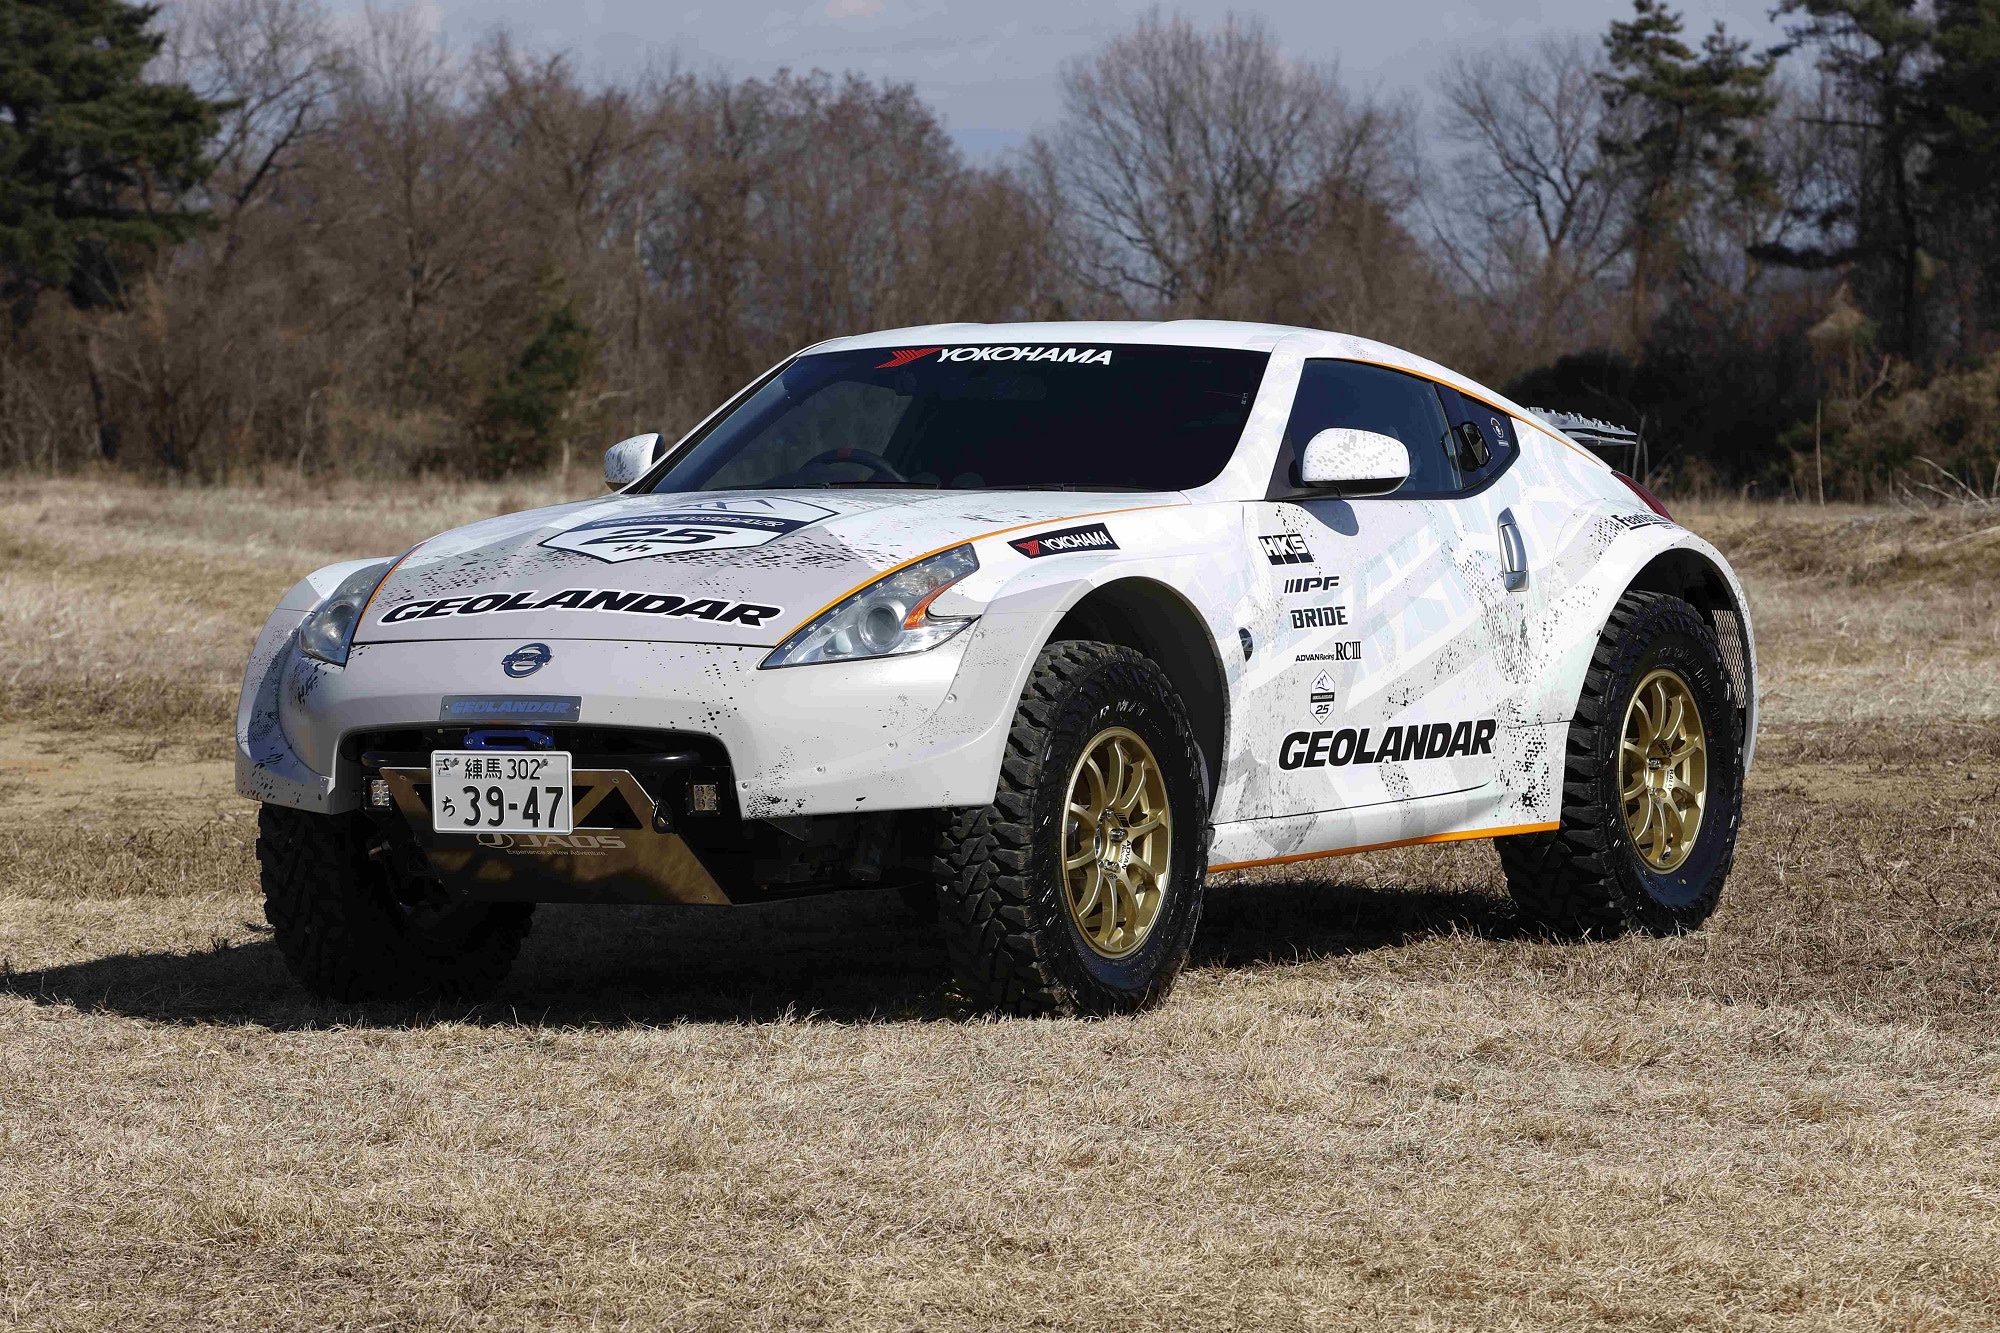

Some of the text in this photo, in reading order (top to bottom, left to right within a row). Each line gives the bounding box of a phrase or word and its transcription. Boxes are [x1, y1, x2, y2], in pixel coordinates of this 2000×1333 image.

[937, 346, 1112, 365] YOKOHAMA
[578, 527, 737, 545] 25
[1039, 530, 1113, 551] YOKOHAMA
[1259, 534, 1310, 558] HKS
[381, 590, 781, 627] GEOLANDAR
[1290, 605, 1348, 629] BRIDE
[1295, 654, 1320, 662] ADVAN
[451, 700, 571, 715] GEOLANDAR
[1315, 704, 1330, 715] 25
[1278, 719, 1496, 770] GEOLANDAR
[464, 758, 503, 780] 練馬
[507, 758, 541, 780] 302
[442, 785, 564, 829] ち 39-47
